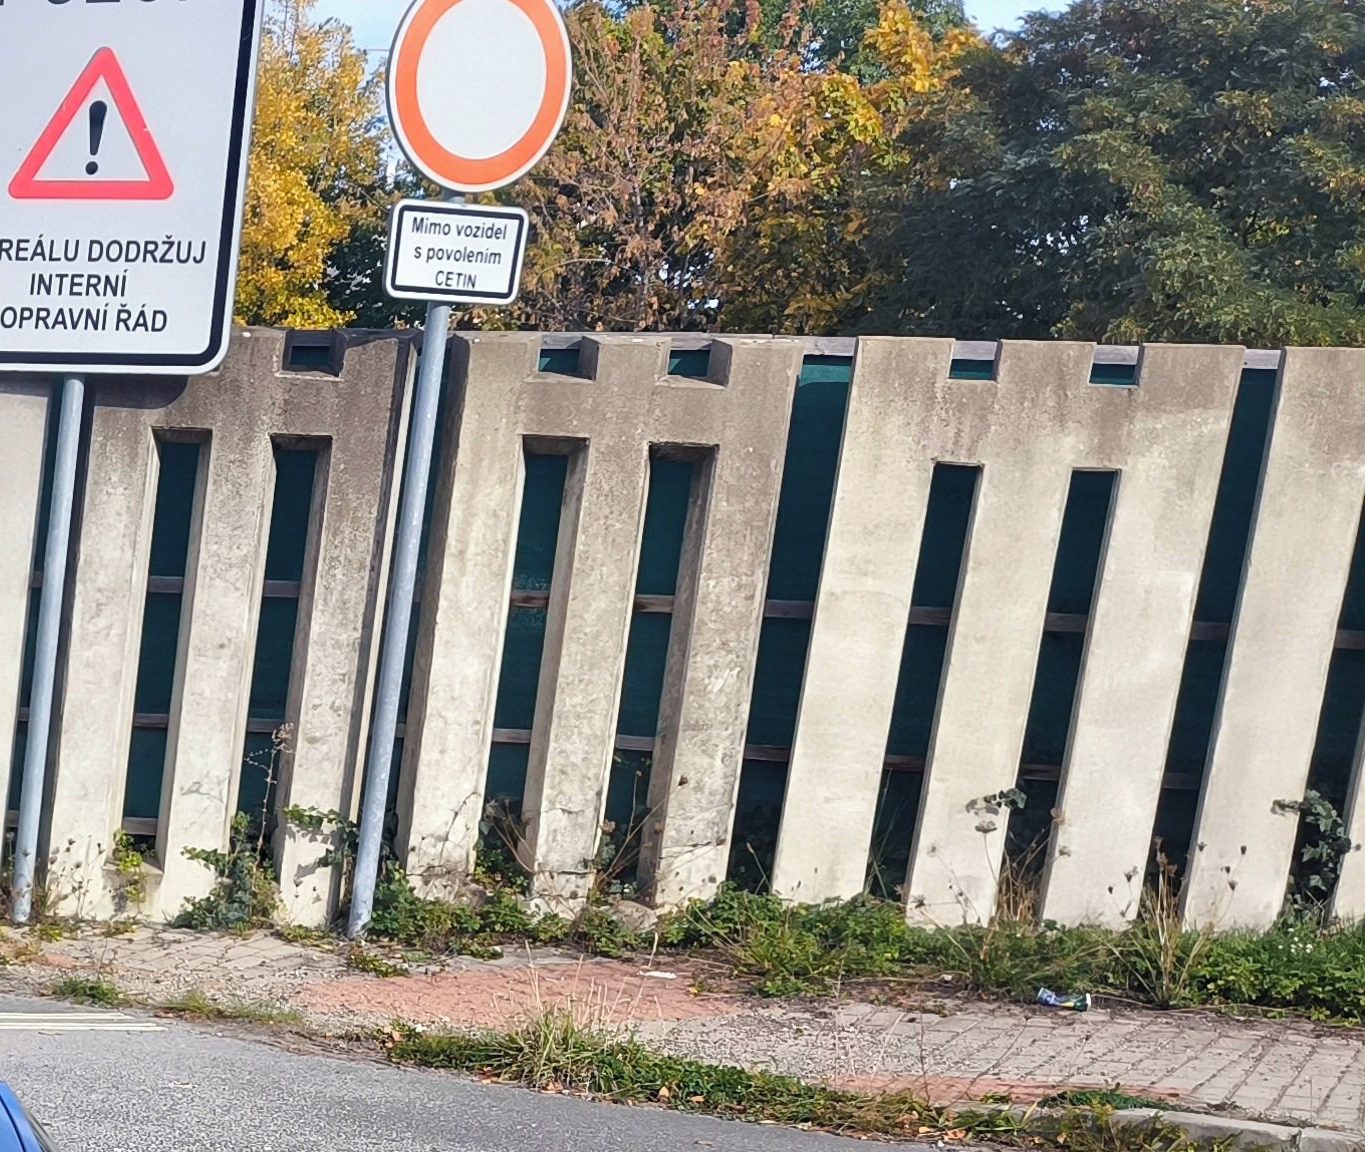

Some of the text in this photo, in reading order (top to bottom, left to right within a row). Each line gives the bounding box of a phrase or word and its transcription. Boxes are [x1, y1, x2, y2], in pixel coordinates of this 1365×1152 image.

[411, 217, 508, 240] Mimo vozidel
[87, 234, 207, 264] DODRŽUJ
[414, 246, 422, 259] s
[29, 268, 129, 297] INTERNÍ
[434, 270, 477, 289] CETIN
[115, 303, 168, 332] ŘÁD
